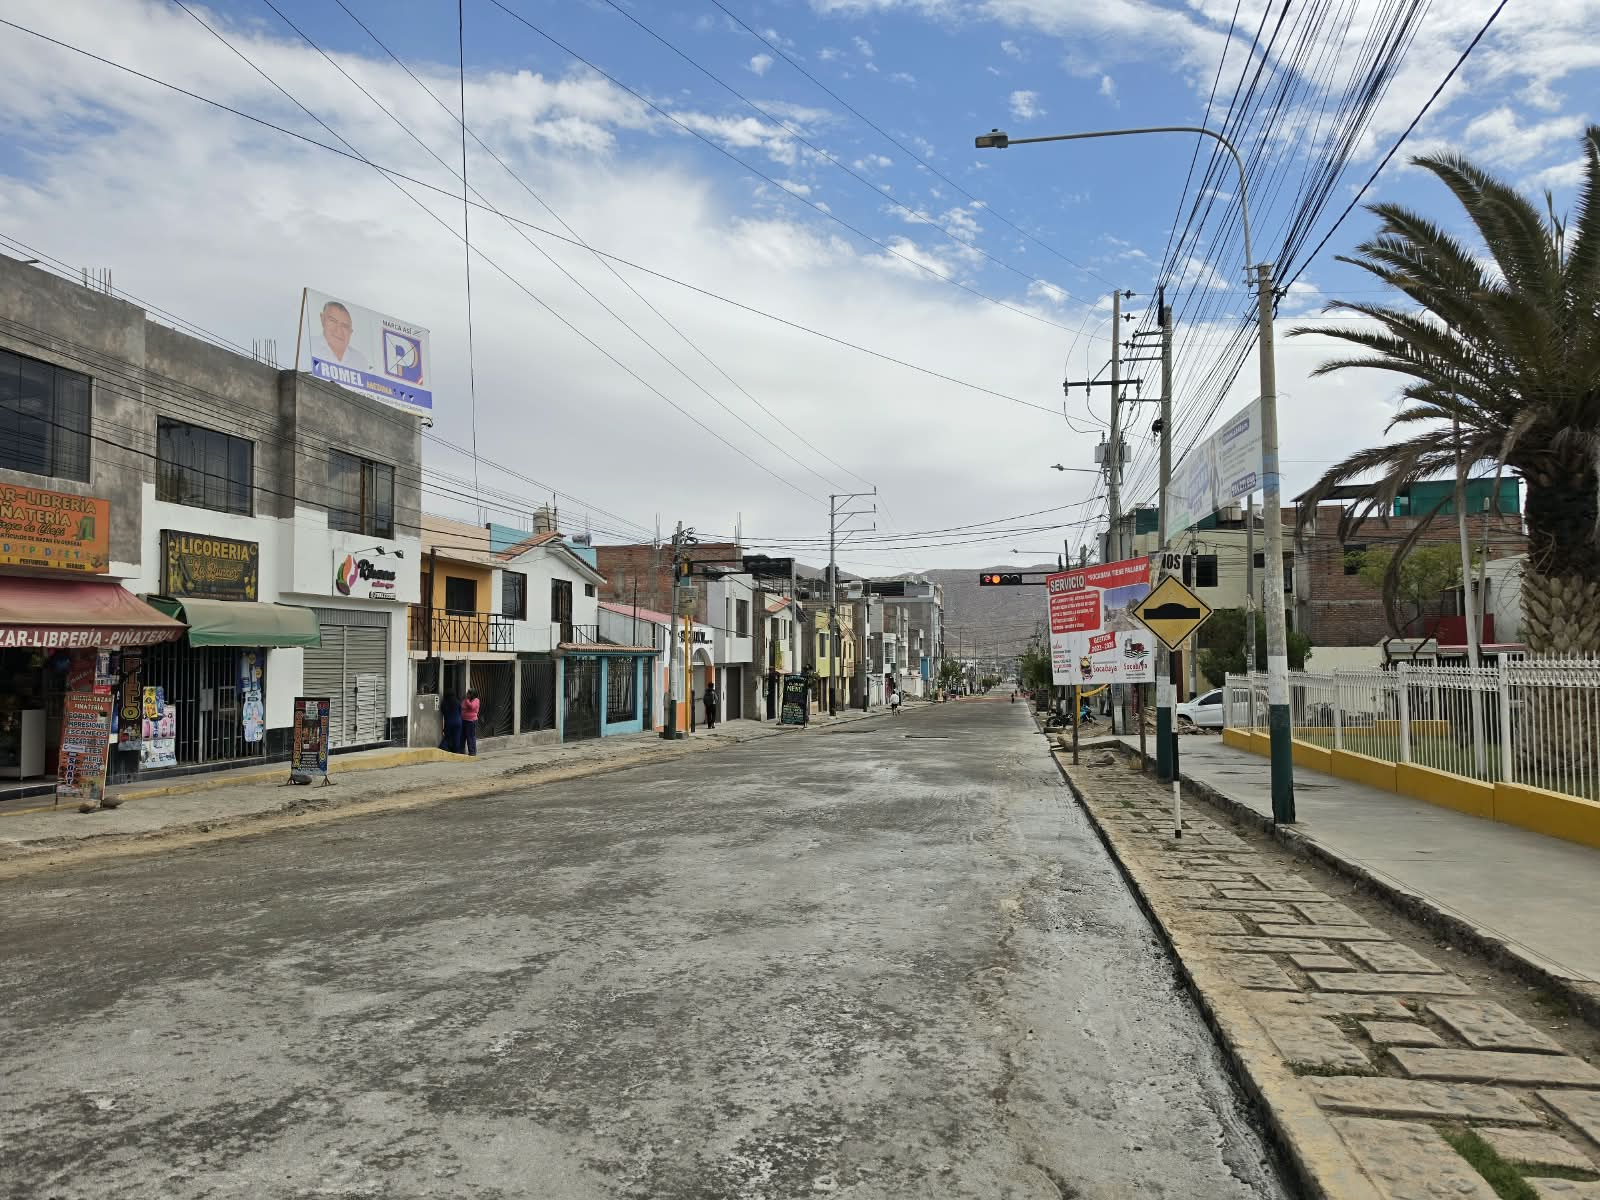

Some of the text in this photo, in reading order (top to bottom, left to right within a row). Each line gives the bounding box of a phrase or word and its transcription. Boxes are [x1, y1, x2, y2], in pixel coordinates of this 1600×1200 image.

[382, 319, 401, 331] MARCA
[320, 362, 364, 387] ROMEL
[181, 535, 249, 561] LICORERIA
[1050, 574, 1085, 594] SERVICIO
[1092, 664, 1118, 674] Socabaya
